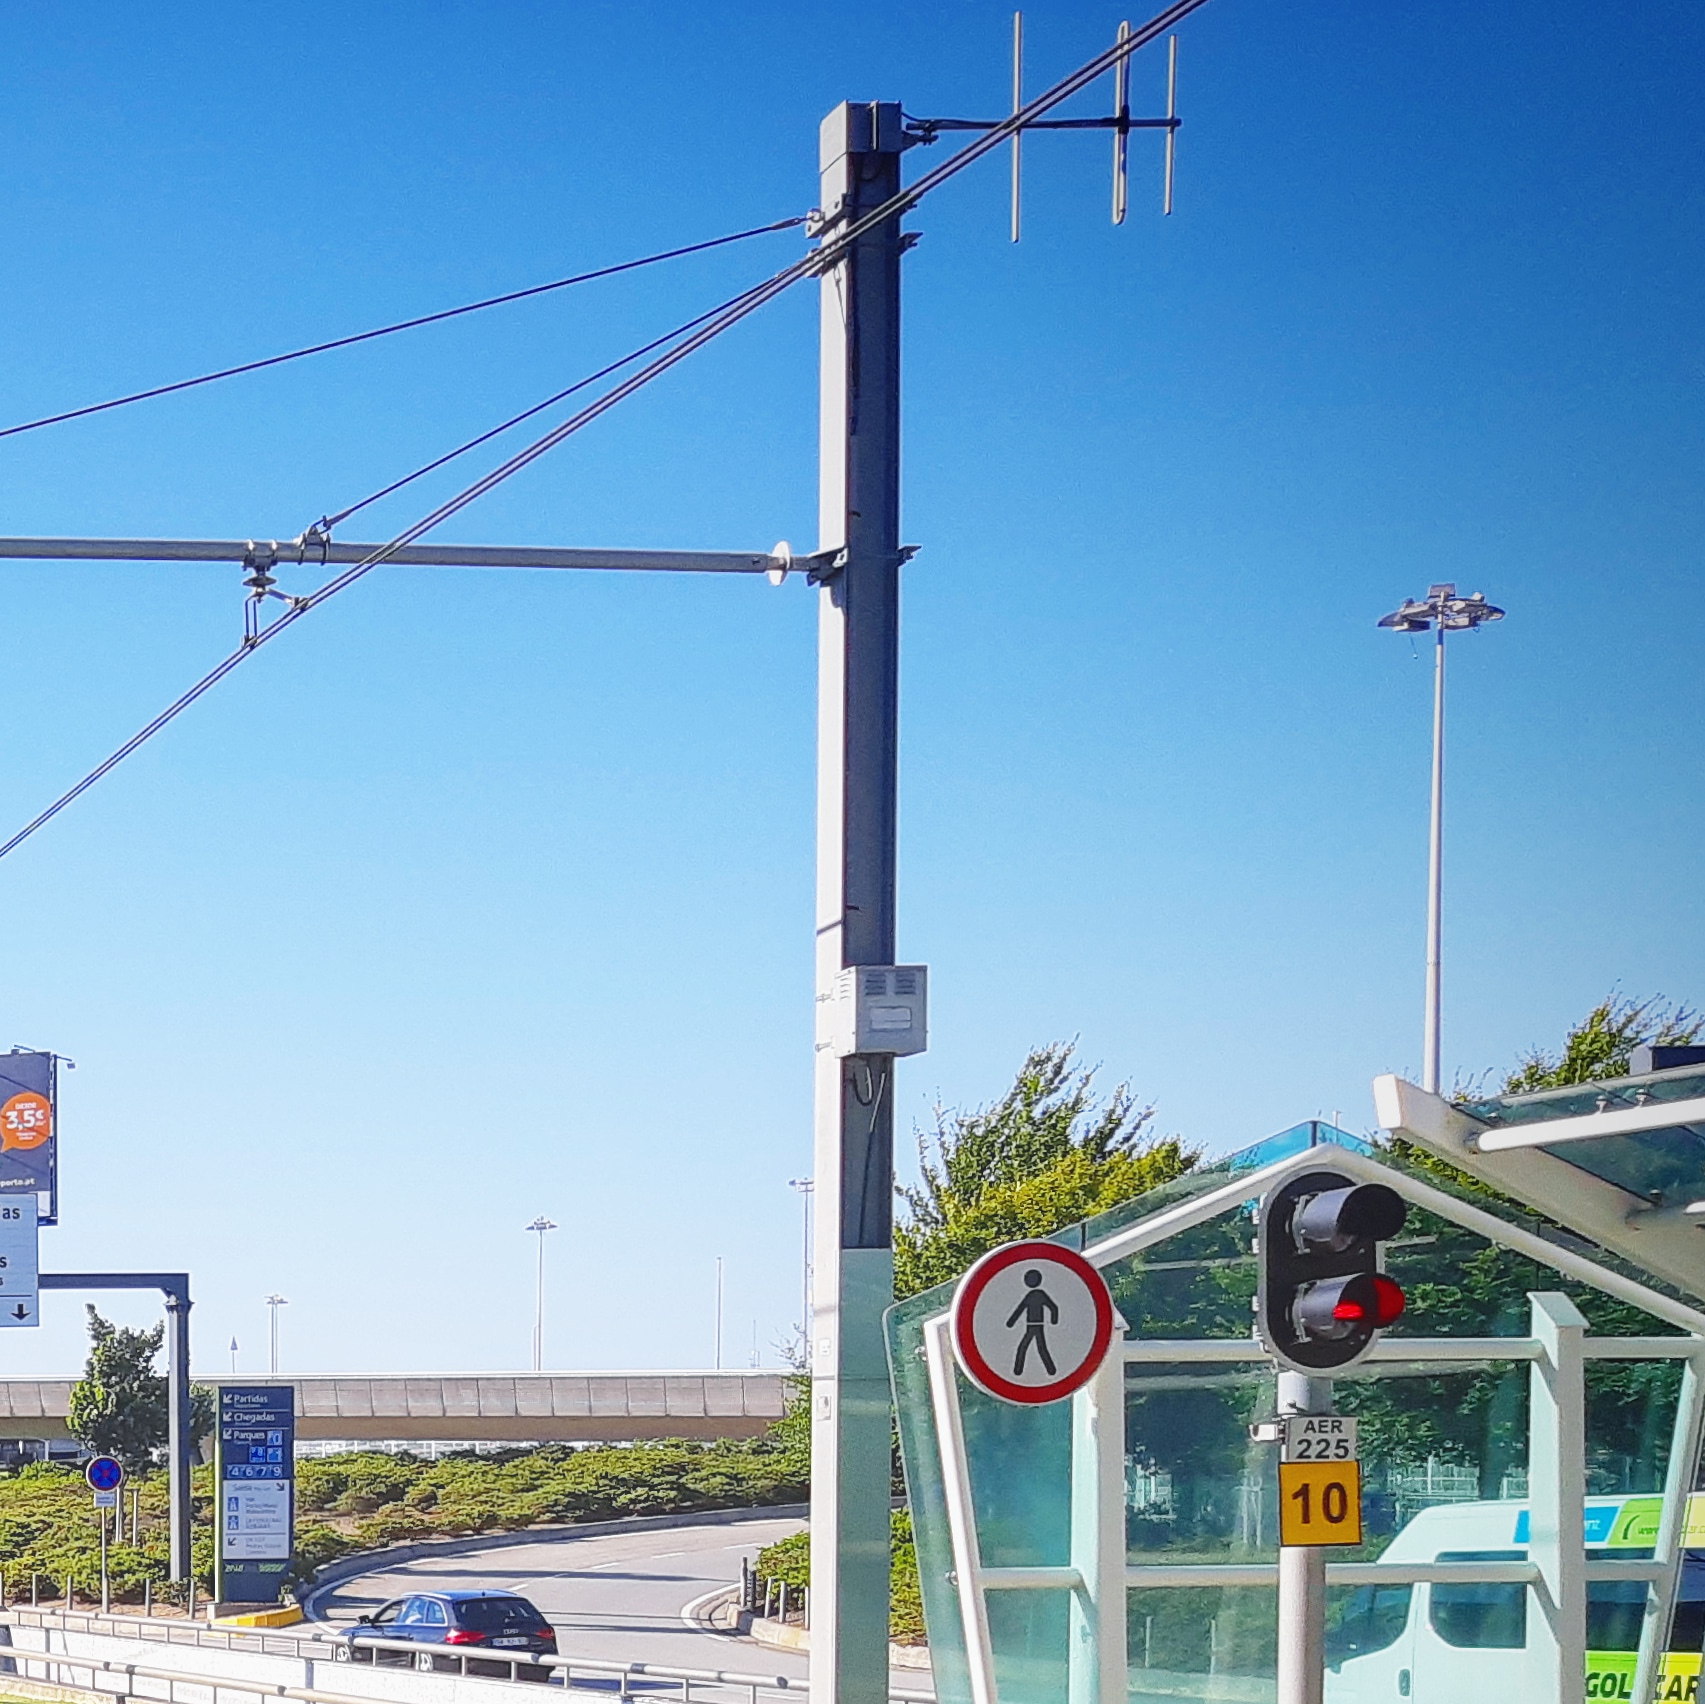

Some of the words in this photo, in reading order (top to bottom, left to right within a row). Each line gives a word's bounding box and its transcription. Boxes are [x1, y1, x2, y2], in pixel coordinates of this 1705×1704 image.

[234, 1394, 268, 1403] Partidas
[234, 1411, 275, 1422] Chegadas
[1303, 1419, 1343, 1434] AER
[1296, 1438, 1350, 1459] 225
[1292, 1482, 1348, 1525] 10
